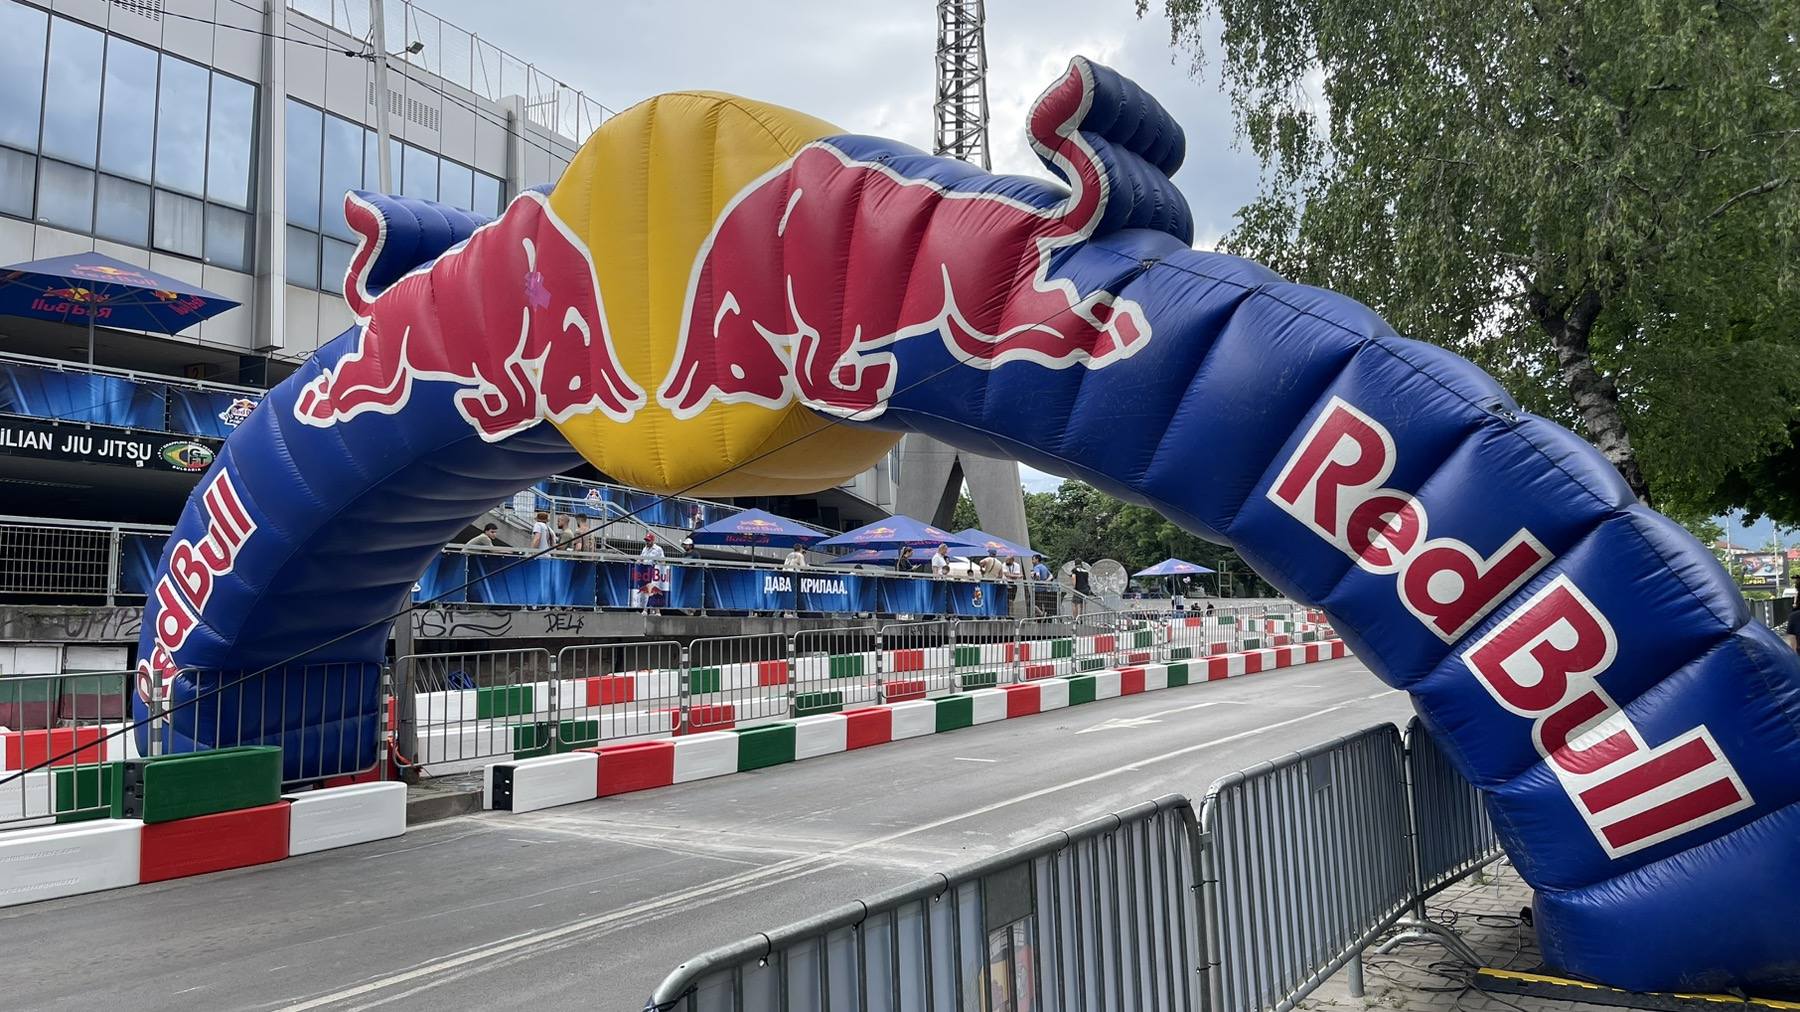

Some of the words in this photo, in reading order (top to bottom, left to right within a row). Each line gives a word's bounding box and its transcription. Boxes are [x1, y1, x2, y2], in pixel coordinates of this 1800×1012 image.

[0, 427, 53, 450] ILIAN
[61, 435, 93, 455] JIU
[97, 439, 152, 461] JITSU
[171, 469, 255, 613] Bull
[763, 576, 793, 594] ДАВА
[800, 577, 848, 595] КРИЛААА.
[1270, 400, 1550, 641] Red
[1465, 578, 1750, 856] Bull
